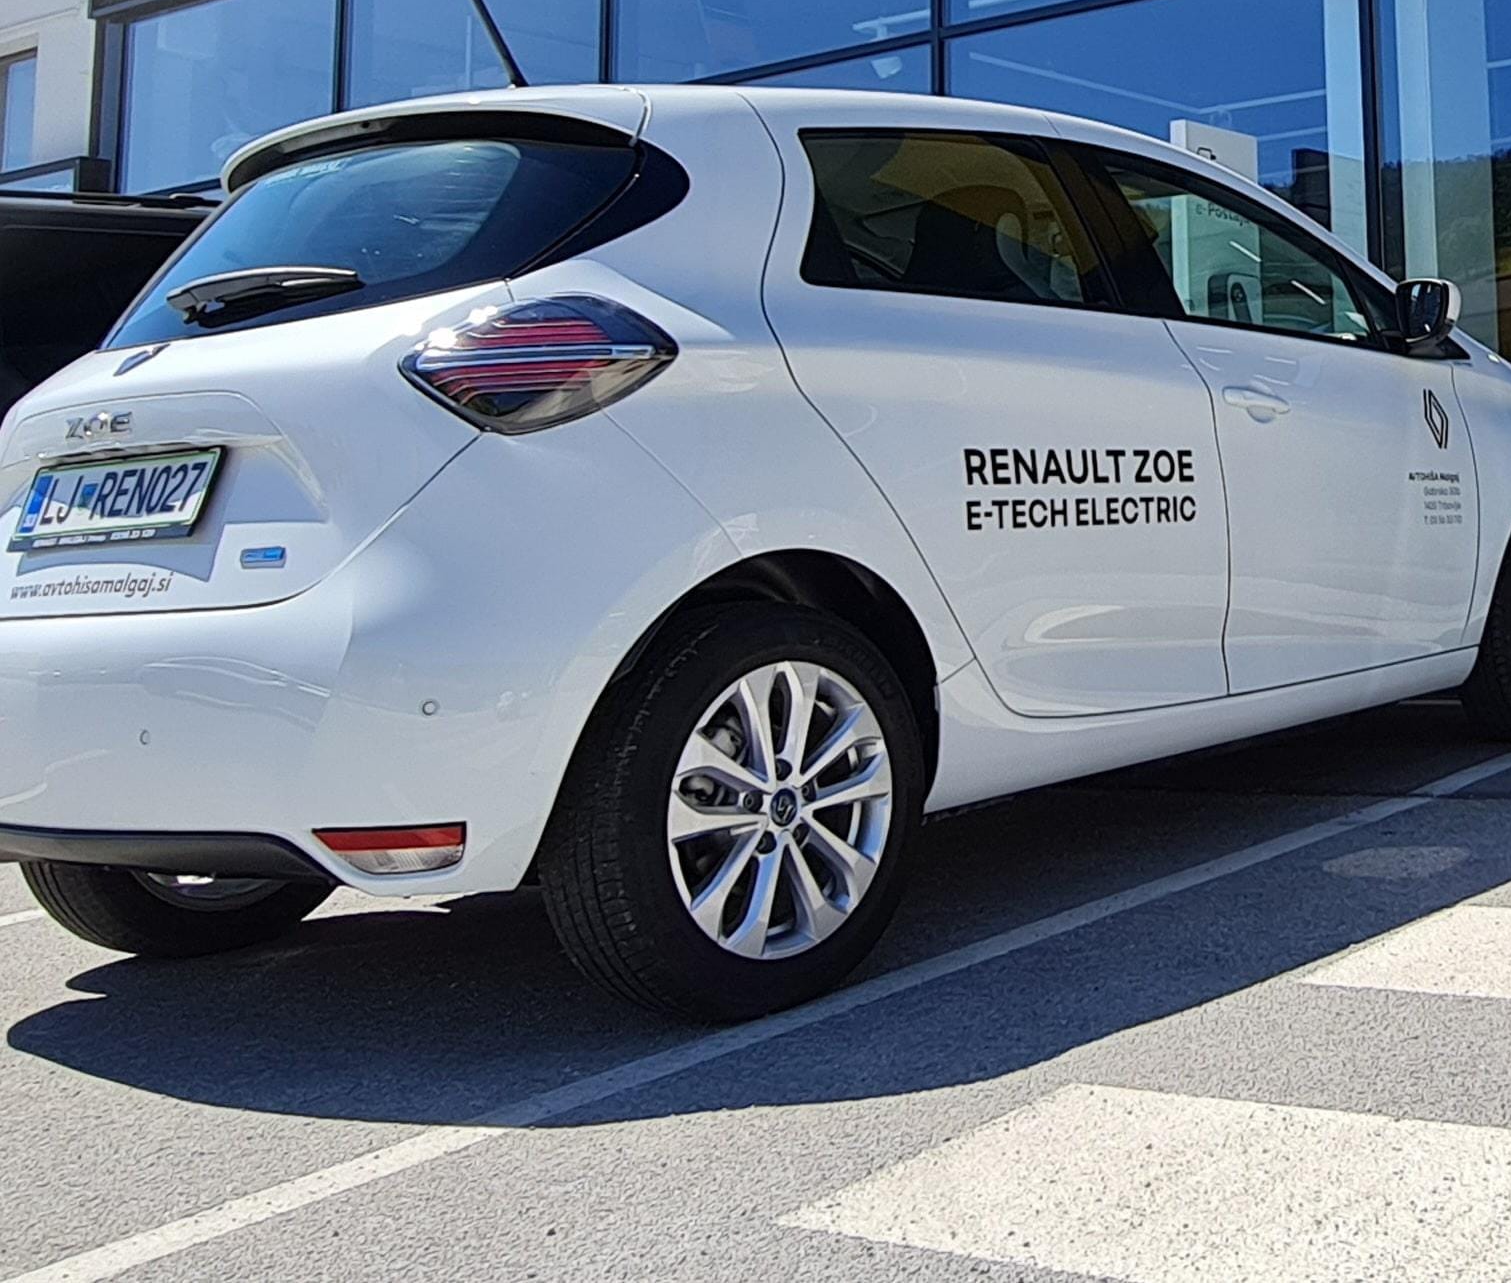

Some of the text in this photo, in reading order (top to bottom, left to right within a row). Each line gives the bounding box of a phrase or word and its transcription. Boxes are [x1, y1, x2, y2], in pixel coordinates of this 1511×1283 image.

[65, 411, 132, 439] ZOE
[963, 449, 1195, 486] RENAULT ZOE
[40, 475, 84, 525] LJ
[966, 495, 1197, 531] E-TECH ELECTRIC
[11, 572, 174, 600] www.avtohisamalgaj.si
